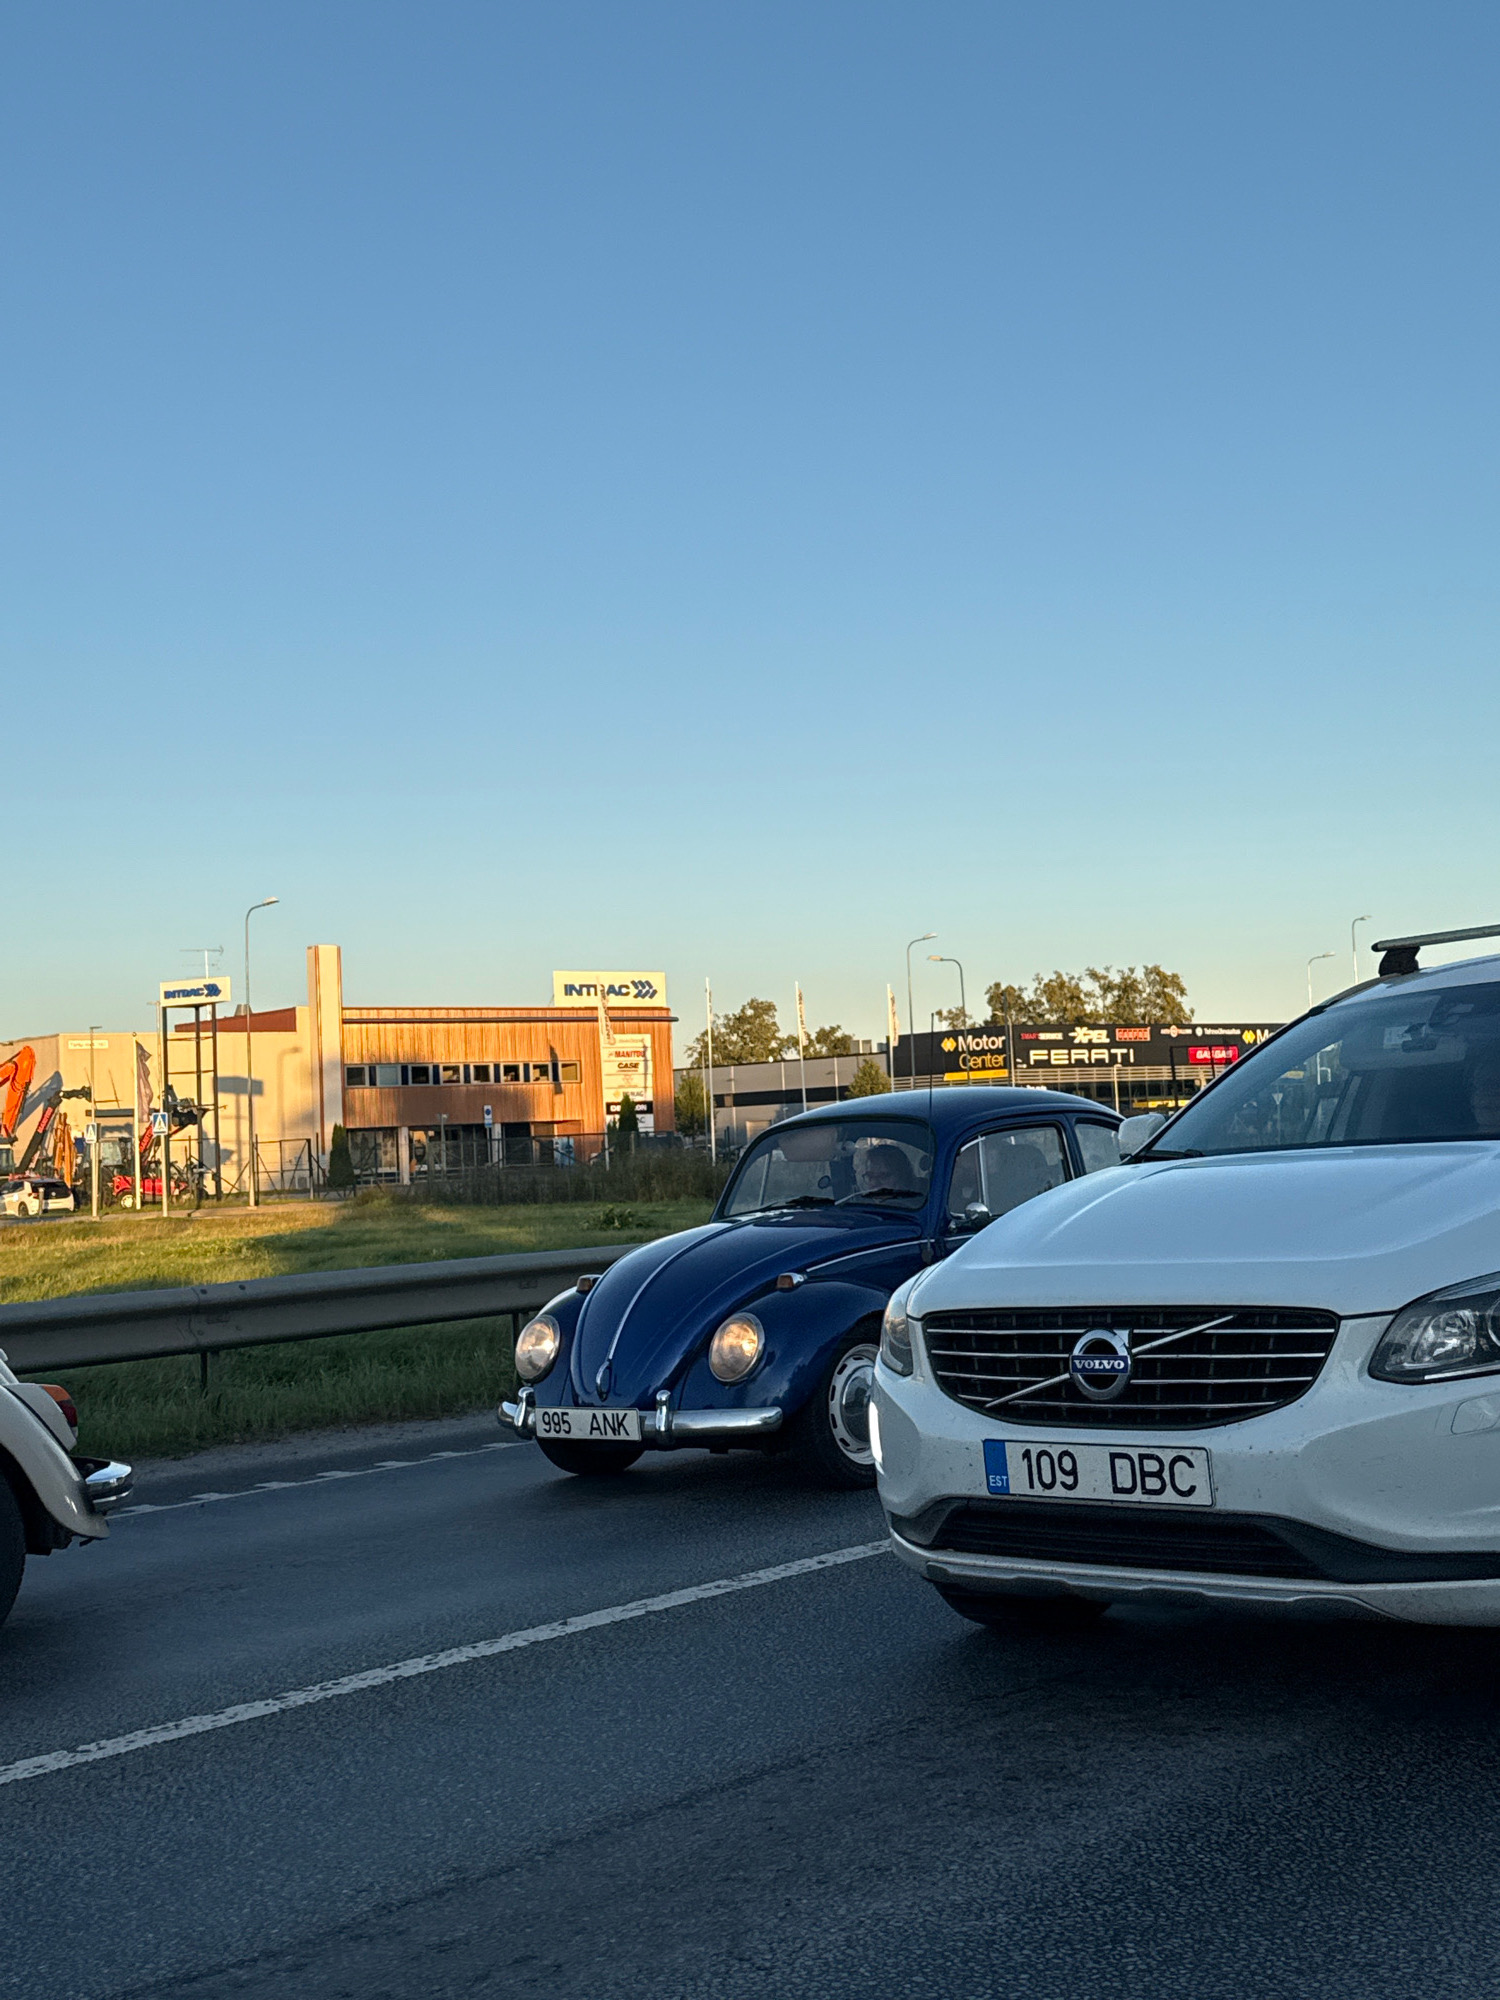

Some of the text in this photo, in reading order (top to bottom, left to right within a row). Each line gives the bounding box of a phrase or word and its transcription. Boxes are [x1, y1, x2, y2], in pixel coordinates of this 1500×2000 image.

[958, 1034, 1006, 1052] Motor
[959, 1052, 1006, 1069] Center
[1029, 1048, 1134, 1065] FERATI
[1073, 1359, 1125, 1370] VOLVO
[542, 1411, 630, 1436] 995 ANK
[989, 1475, 1008, 1487] EST
[1022, 1448, 1197, 1497] 109 DBC
